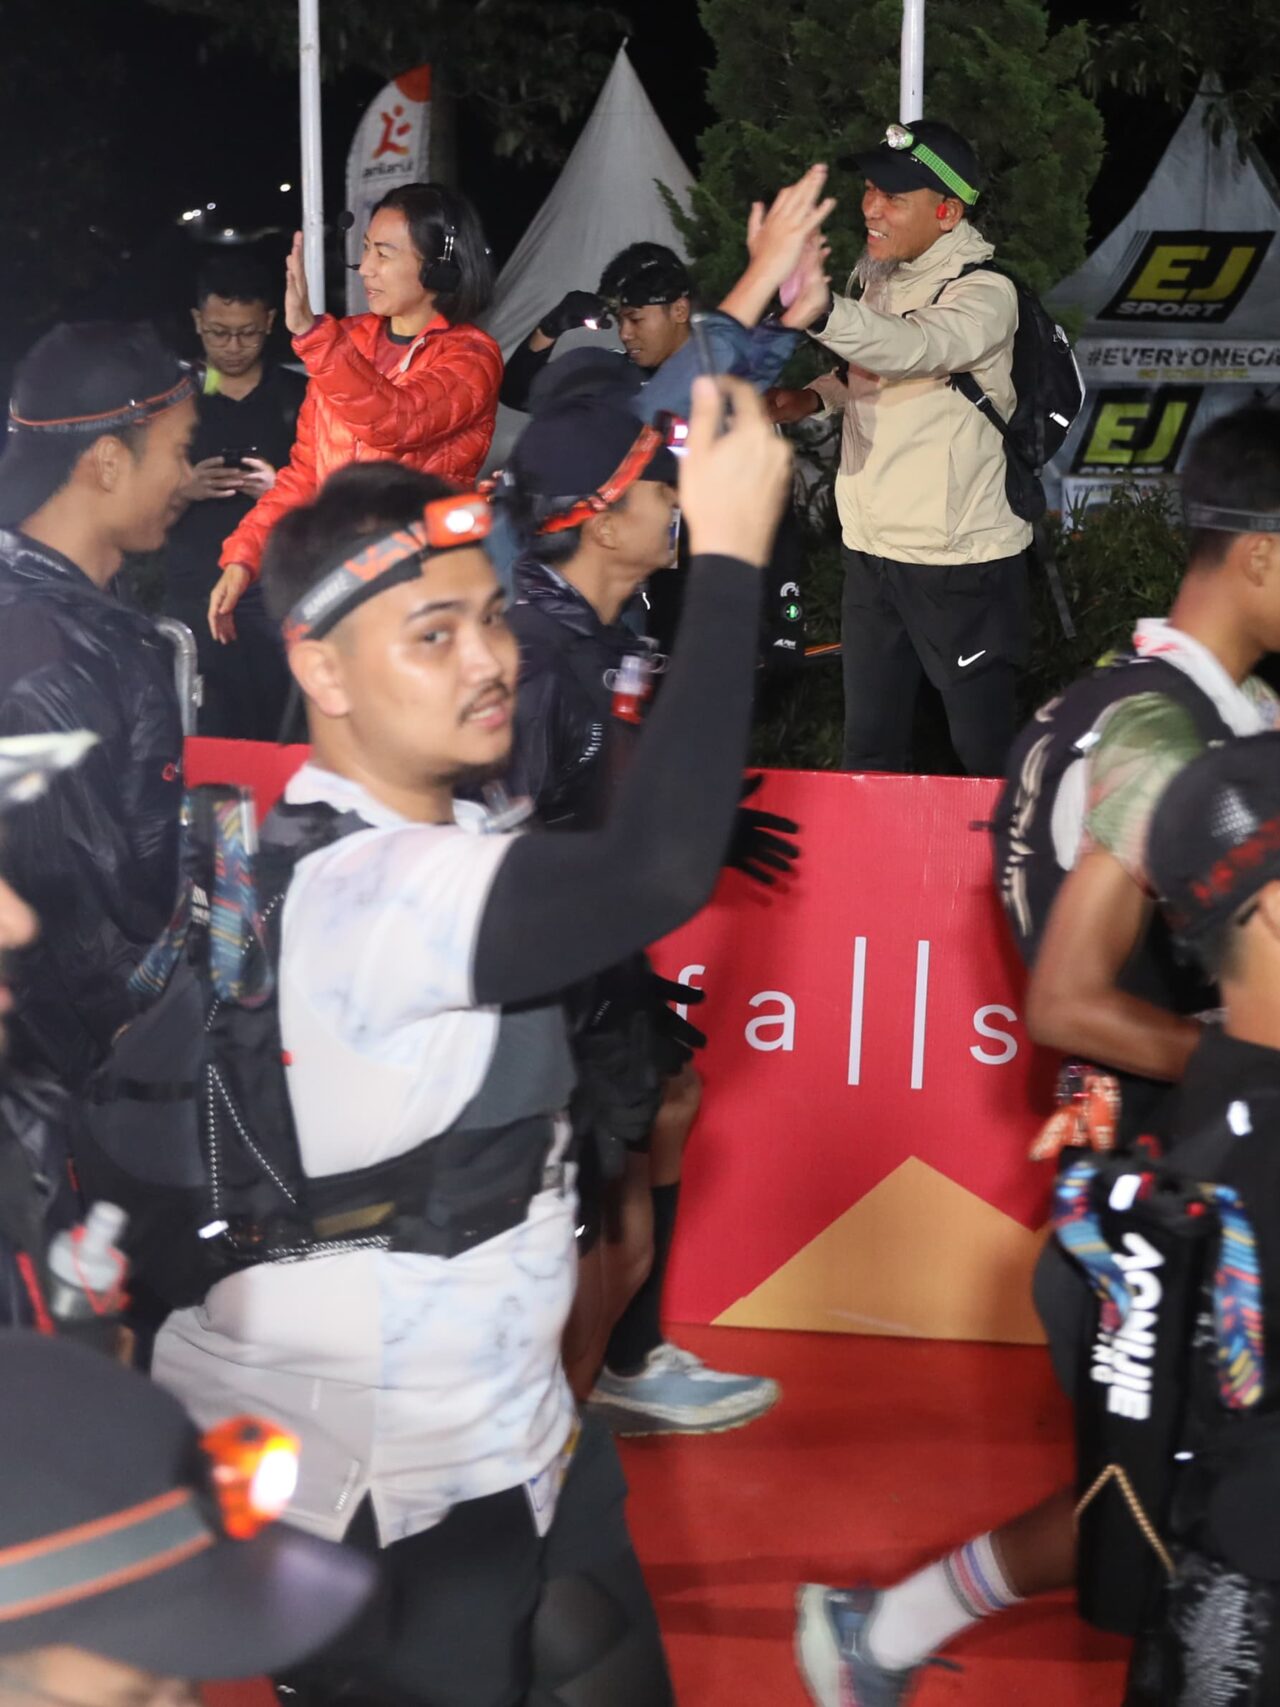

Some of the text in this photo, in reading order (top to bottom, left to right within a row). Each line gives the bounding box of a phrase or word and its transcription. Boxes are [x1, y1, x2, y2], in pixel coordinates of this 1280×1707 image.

[1127, 246, 1256, 301] EJ
[1116, 301, 1224, 317] SPORT
[1083, 402, 1189, 464] EJ
